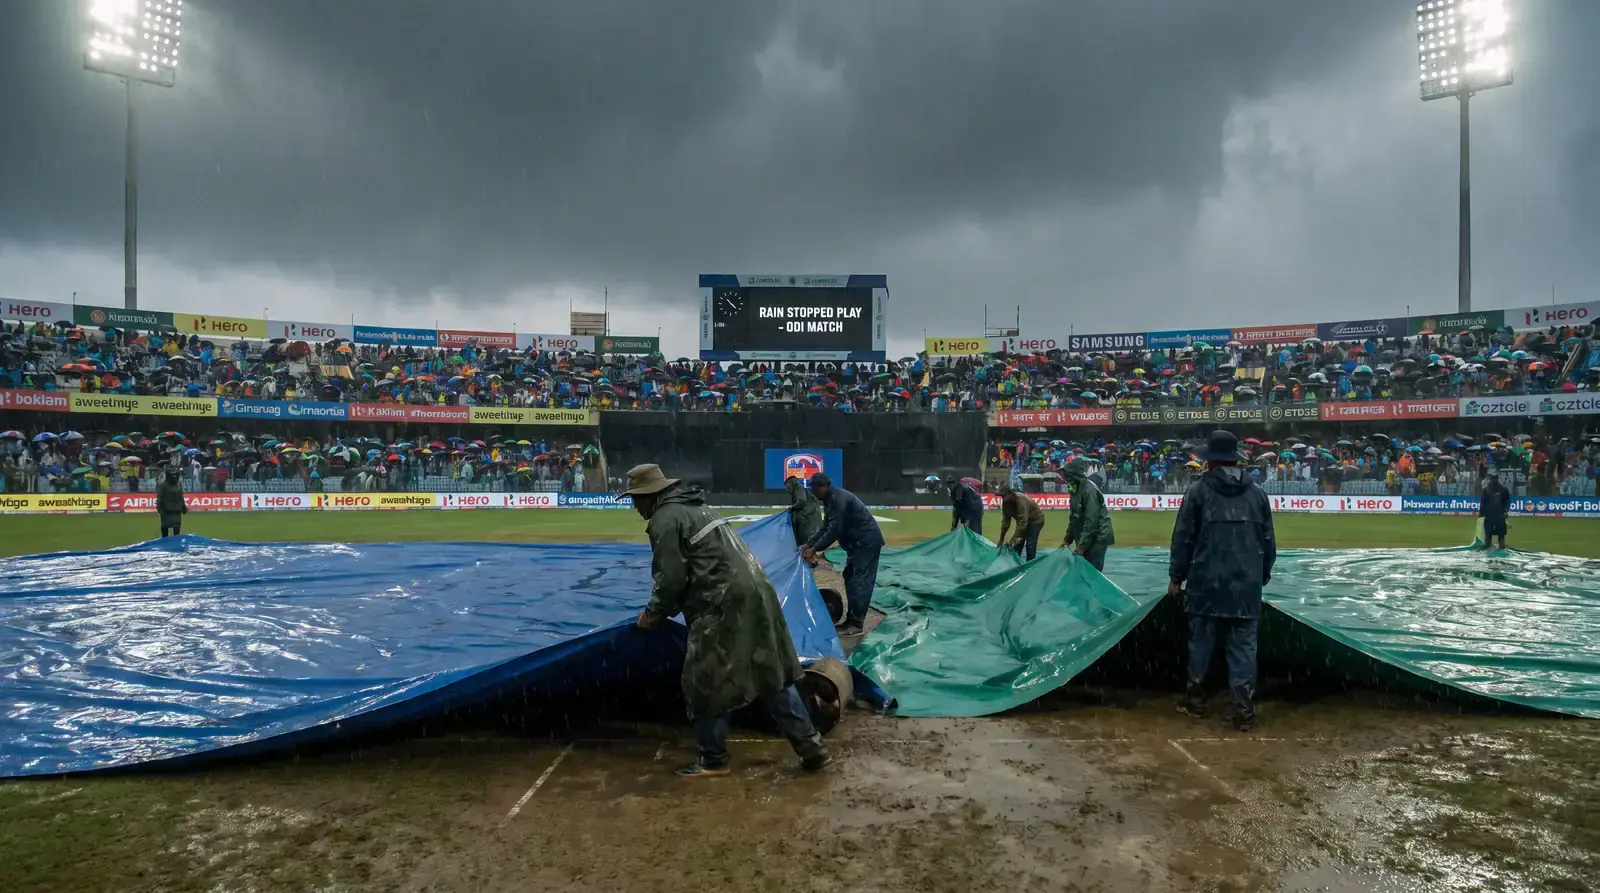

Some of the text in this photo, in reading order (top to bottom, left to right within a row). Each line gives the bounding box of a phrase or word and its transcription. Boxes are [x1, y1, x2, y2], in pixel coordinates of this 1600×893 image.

[8, 303, 52, 318] Hero
[759, 306, 862, 318] RAIN STOPPED PLAY
[1545, 307, 1588, 321] Hero
[212, 320, 248, 333] Hero
[301, 326, 336, 338] Hero
[786, 321, 804, 333] ODI
[807, 321, 843, 333] MATCH
[547, 338, 578, 348] Hero
[948, 340, 979, 351] Hero
[1019, 338, 1056, 350] Hero
[1071, 335, 1144, 349] SAMSUNG
[265, 496, 302, 506] Hero
[334, 496, 371, 506] Hero
[458, 496, 490, 505] Hero
[519, 495, 549, 505] Hero
[1107, 497, 1138, 507] Hero
[1291, 498, 1325, 508] Hero
[1357, 499, 1392, 509] Hero
